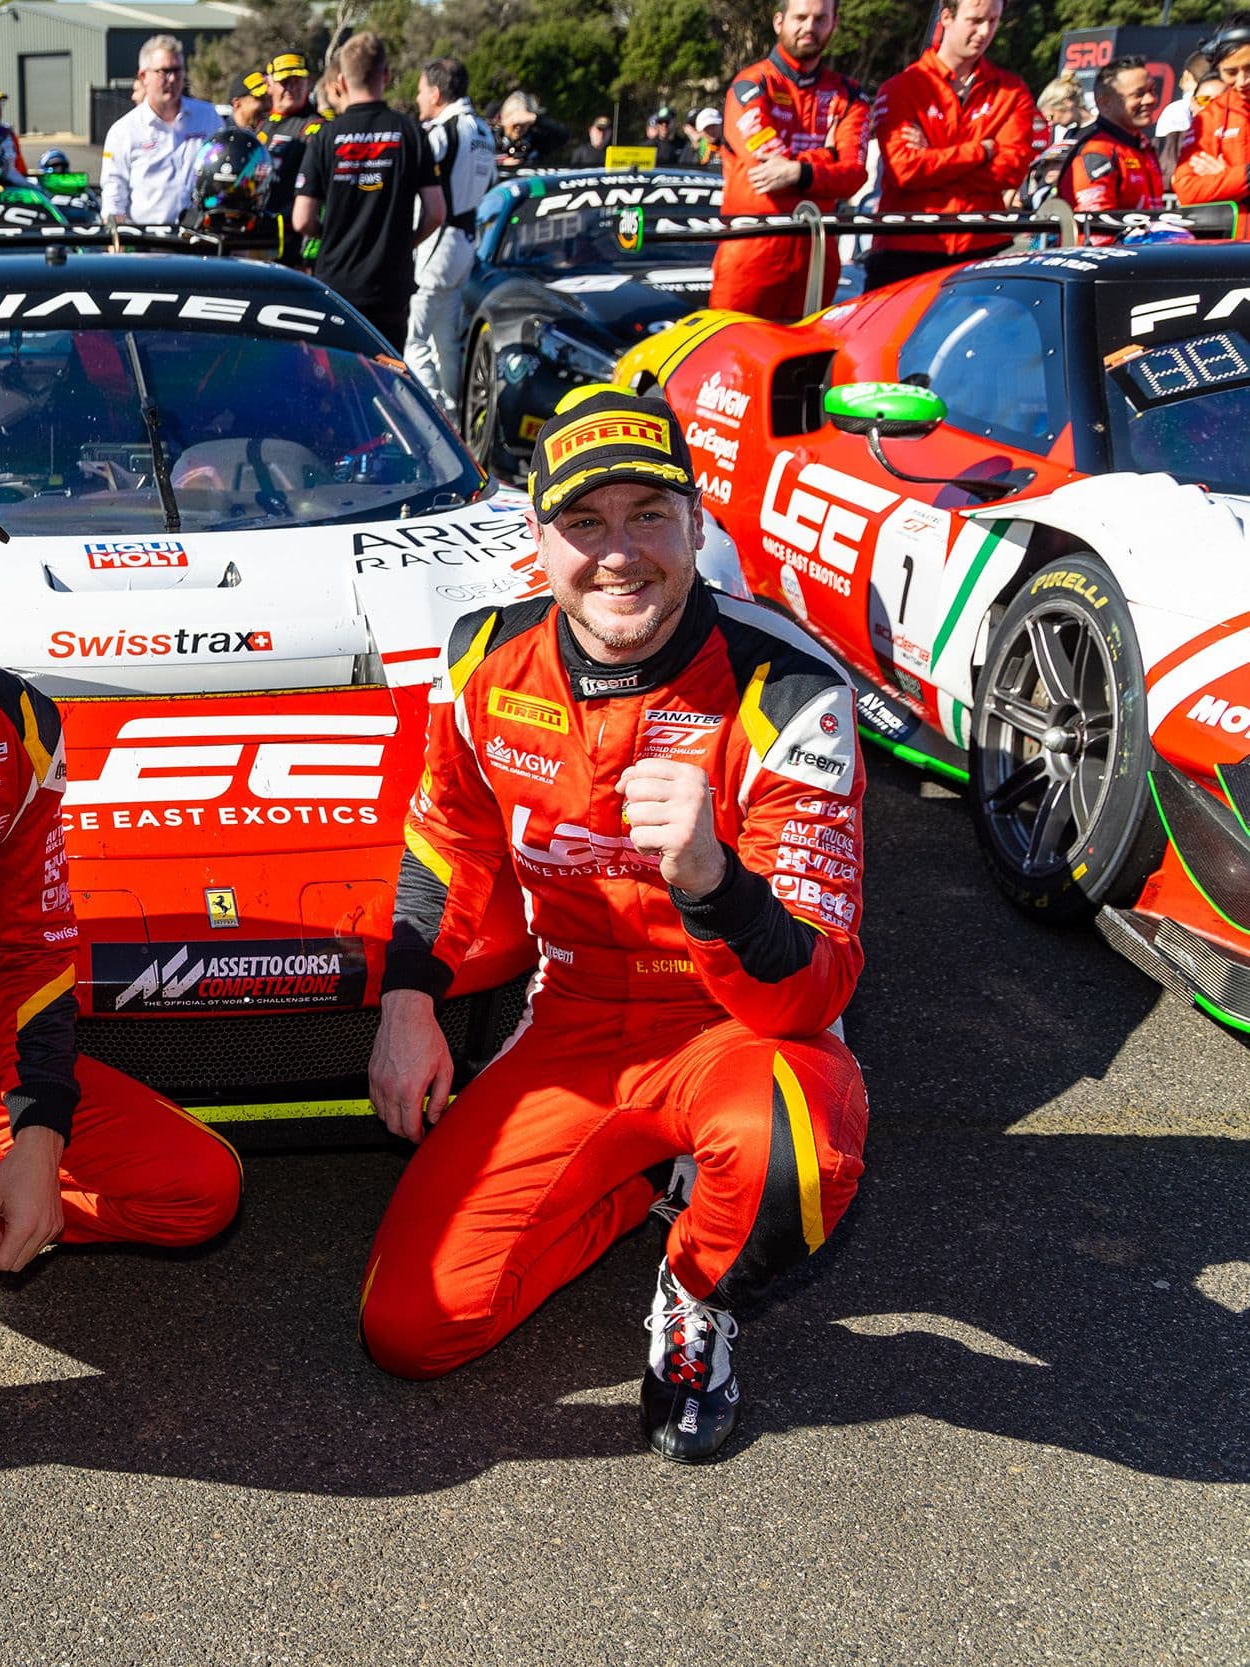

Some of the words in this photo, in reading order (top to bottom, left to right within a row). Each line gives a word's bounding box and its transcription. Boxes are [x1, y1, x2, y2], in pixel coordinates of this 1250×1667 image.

[1066, 41, 1113, 69] SRO
[551, 417, 663, 464] PIRELLI
[760, 450, 902, 574] LEE
[88, 543, 184, 553] LIQUI
[352, 514, 528, 556] ARIS
[92, 551, 185, 568] MOLY
[786, 548, 809, 574] EAST
[809, 560, 851, 597] EXOTICS
[899, 555, 914, 625] 1
[1030, 570, 1109, 609] PIRELLI
[49, 629, 256, 660] Swisstrax
[579, 674, 638, 697] freem
[497, 695, 562, 727] PIRELLI
[859, 692, 883, 710] AV
[647, 711, 723, 724] FANATEC
[1185, 693, 1250, 739] MO
[512, 749, 559, 778] VGW
[124, 807, 205, 827] EAST
[219, 805, 379, 825] EXOTICS
[783, 819, 810, 835] AV
[813, 825, 854, 852] TRUCKS
[558, 862, 601, 877] EAST
[800, 878, 855, 923] Beta
[206, 956, 281, 978] ASSETTO
[284, 953, 341, 976] CORSA
[545, 941, 574, 964] freem
[199, 976, 341, 998] COMPETIZIONE
